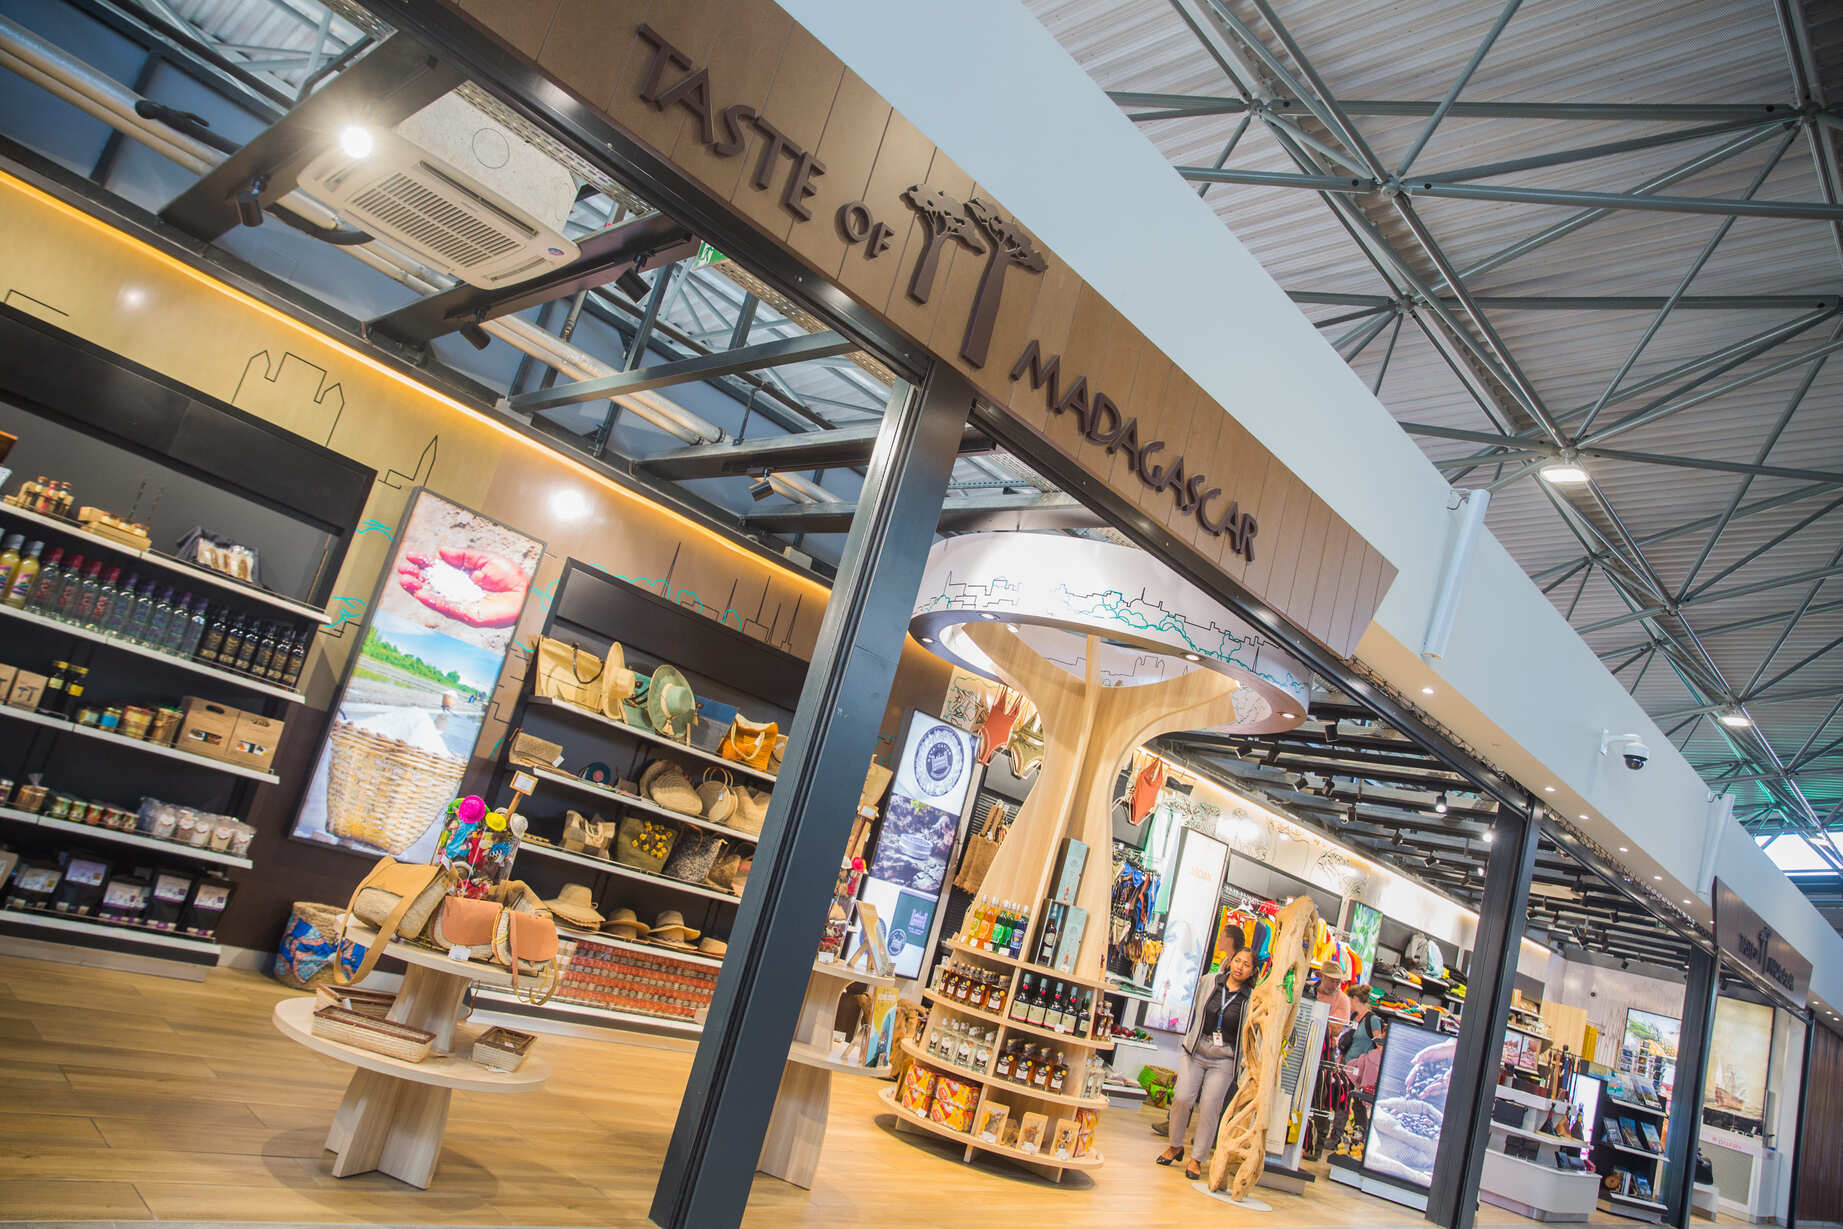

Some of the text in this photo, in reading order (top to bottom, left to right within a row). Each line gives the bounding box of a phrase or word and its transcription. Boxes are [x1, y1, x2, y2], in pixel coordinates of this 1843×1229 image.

[637, 23, 1259, 563] TASTE OF MADAGASCAR
